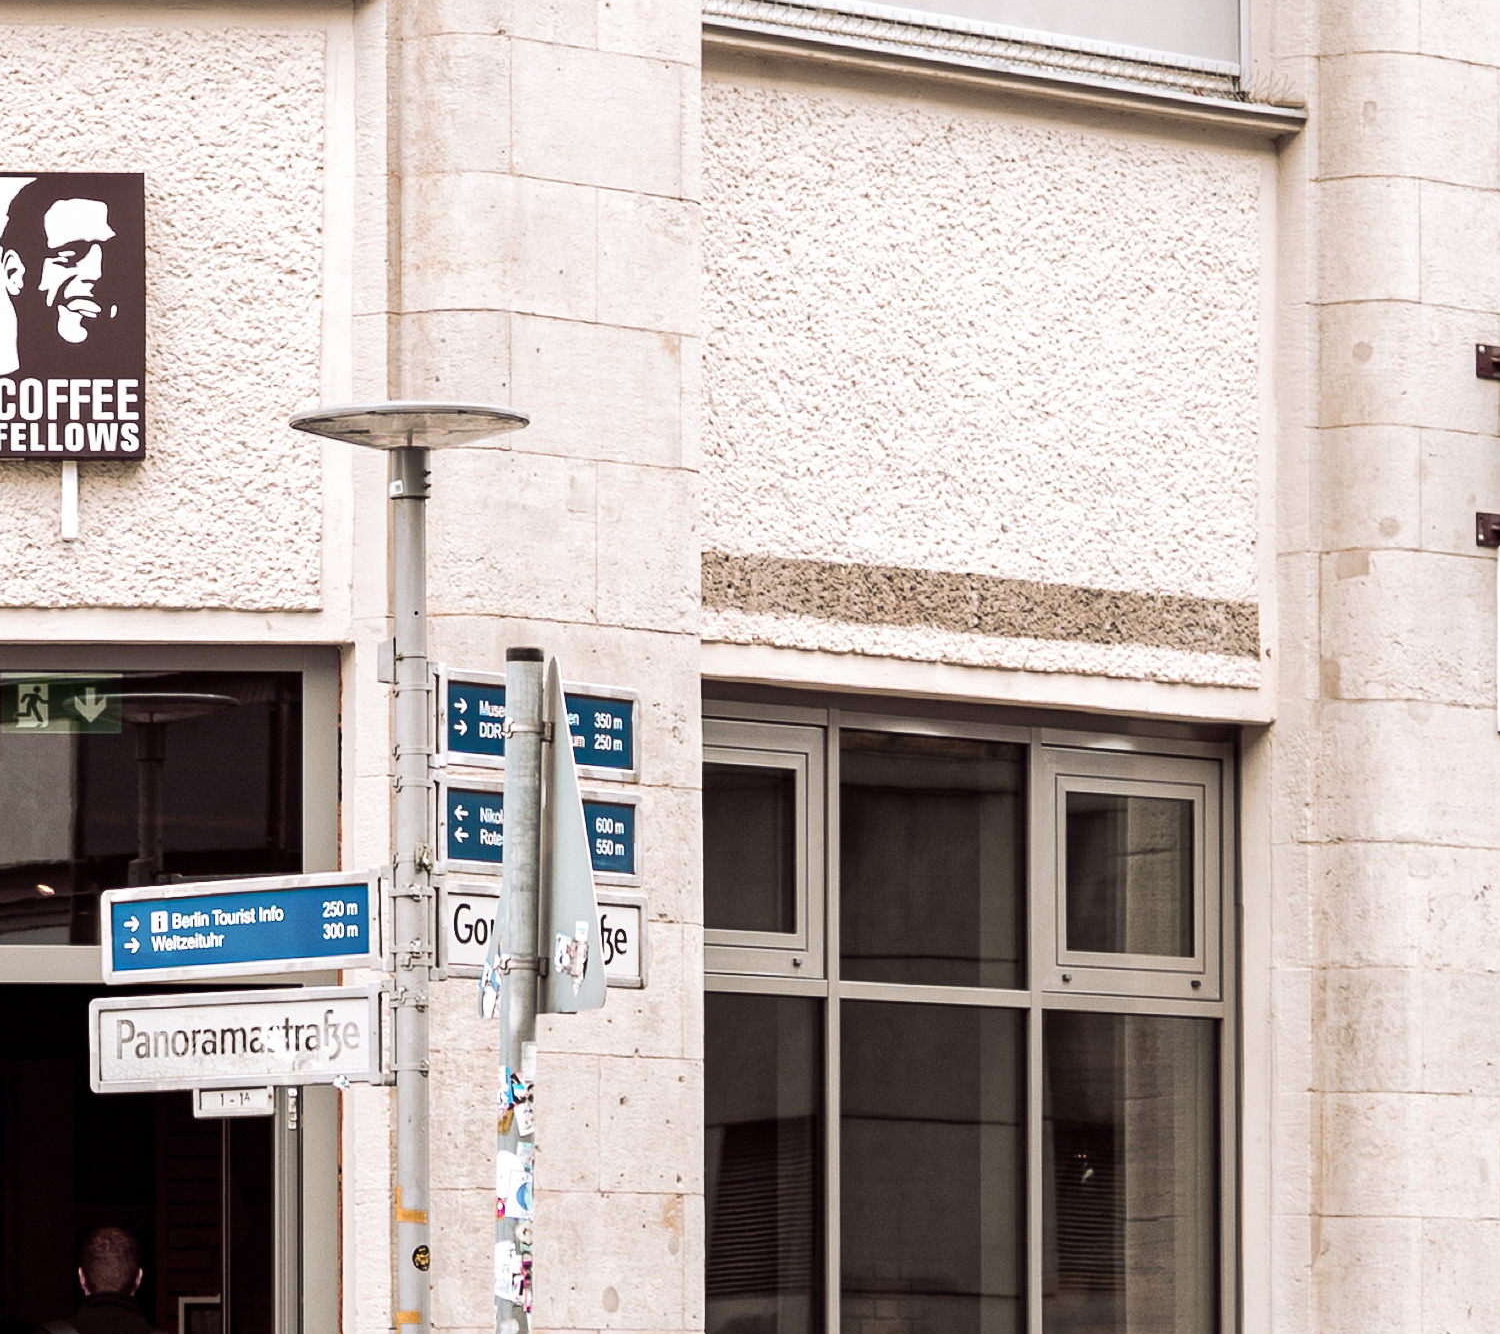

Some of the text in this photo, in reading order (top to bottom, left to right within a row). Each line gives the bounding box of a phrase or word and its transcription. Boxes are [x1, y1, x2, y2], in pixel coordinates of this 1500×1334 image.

[594, 712, 612, 729] 350
[613, 717, 623, 731] m
[594, 734, 612, 751] 250
[613, 738, 623, 752] m
[595, 817, 625, 836] 600 m
[595, 839, 625, 857] 550 m
[171, 911, 209, 929] Berlin
[212, 908, 257, 926] Tourist
[259, 905, 285, 923] Info
[322, 900, 358, 918] 250 m
[322, 923, 358, 940] 300 m
[151, 932, 225, 952] Weltzeituhr
